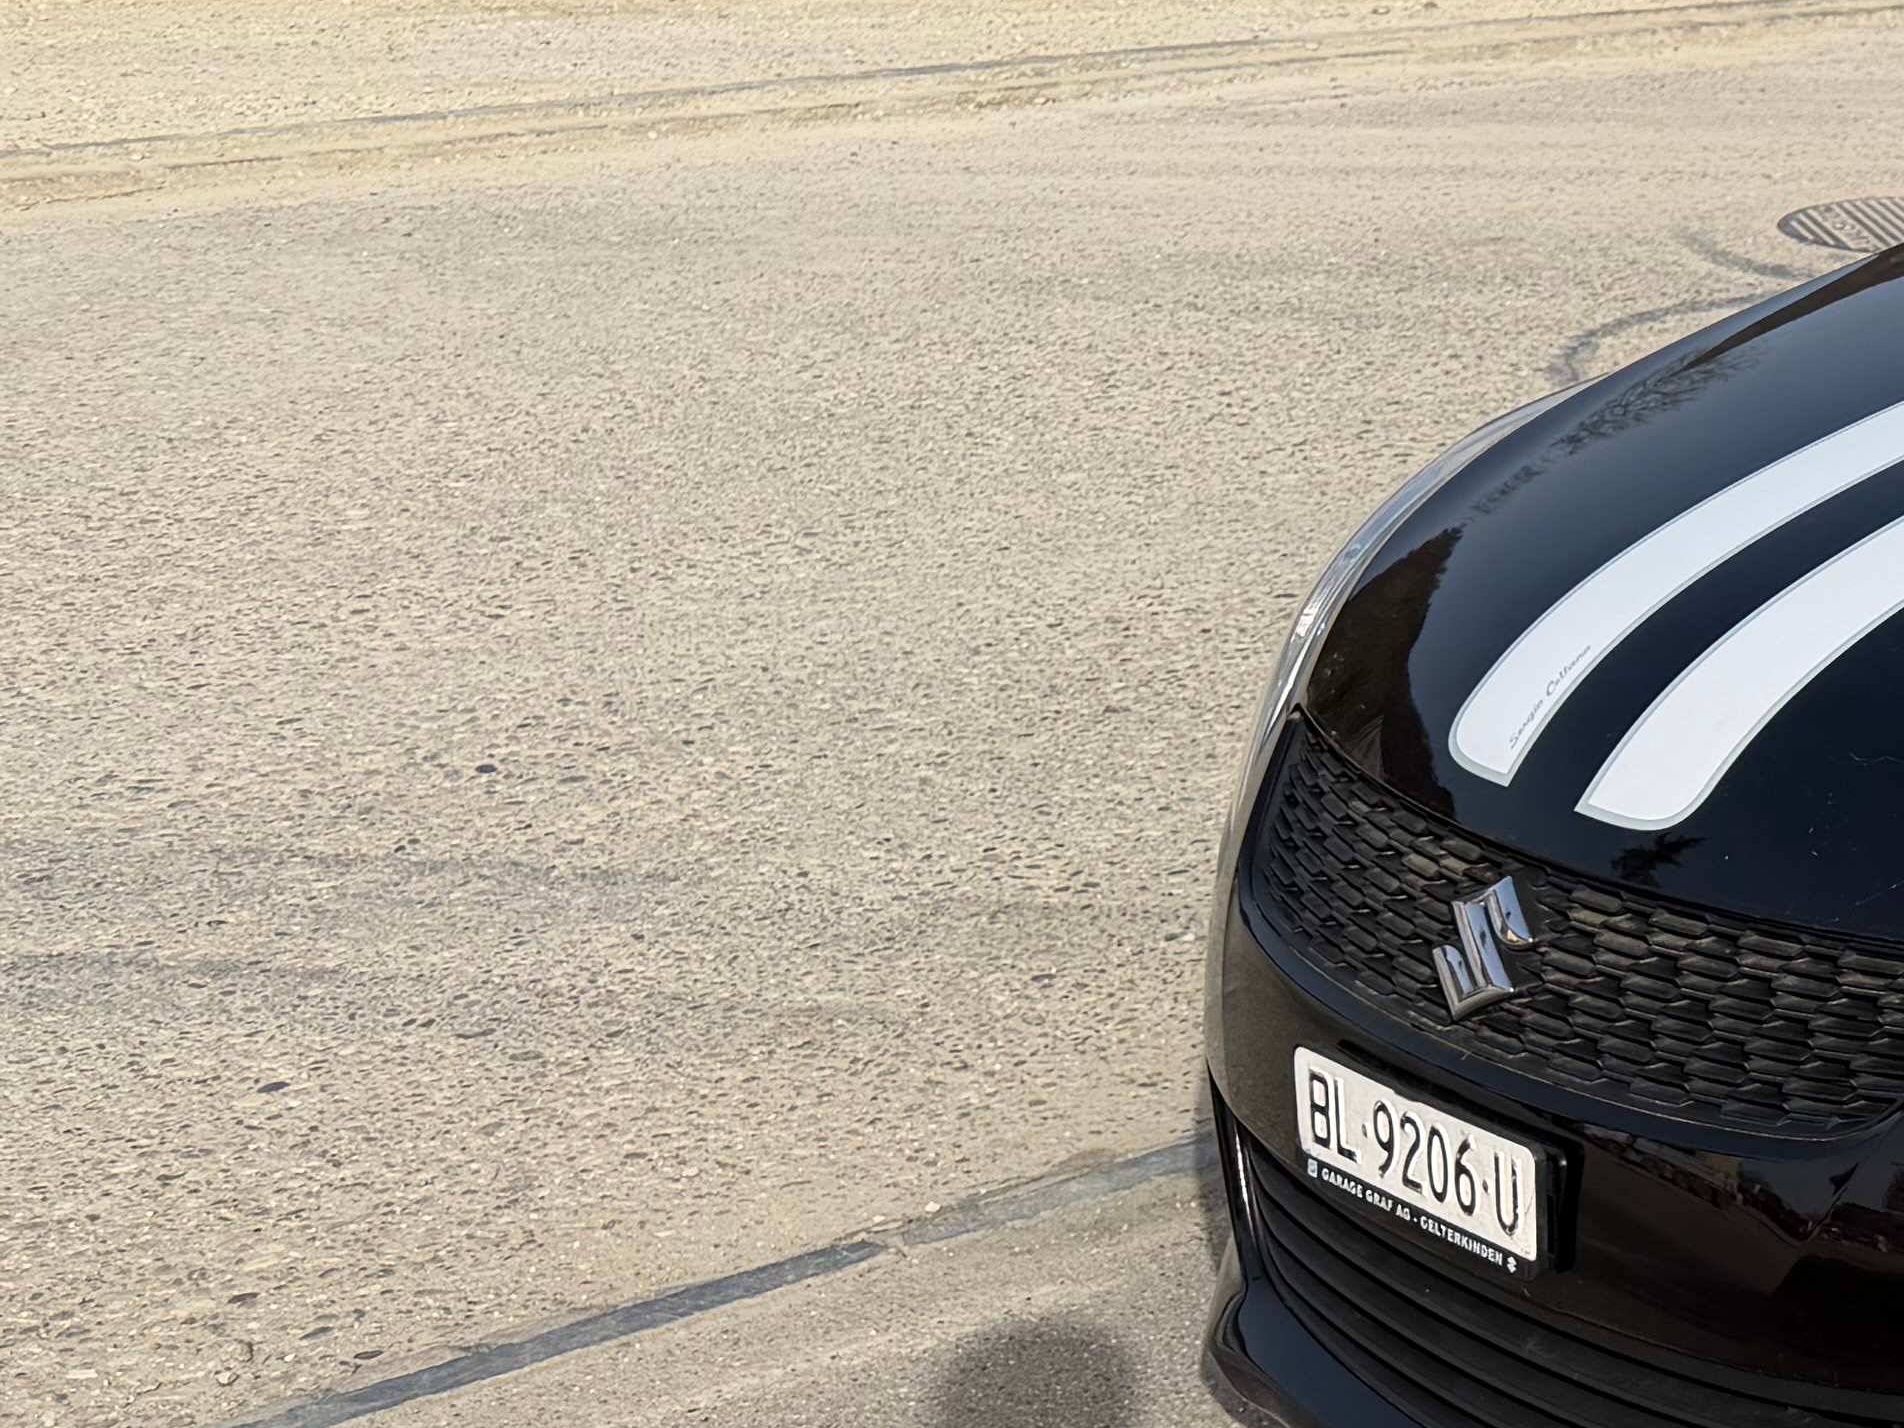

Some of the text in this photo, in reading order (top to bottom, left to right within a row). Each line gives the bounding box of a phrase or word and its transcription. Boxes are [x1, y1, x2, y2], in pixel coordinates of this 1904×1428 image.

[1322, 1167, 1363, 1199] GARAGE
[1365, 1189, 1394, 1212] GRAF
[1396, 1204, 1411, 1221] AG
[1371, 1098, 1482, 1217] 9206
